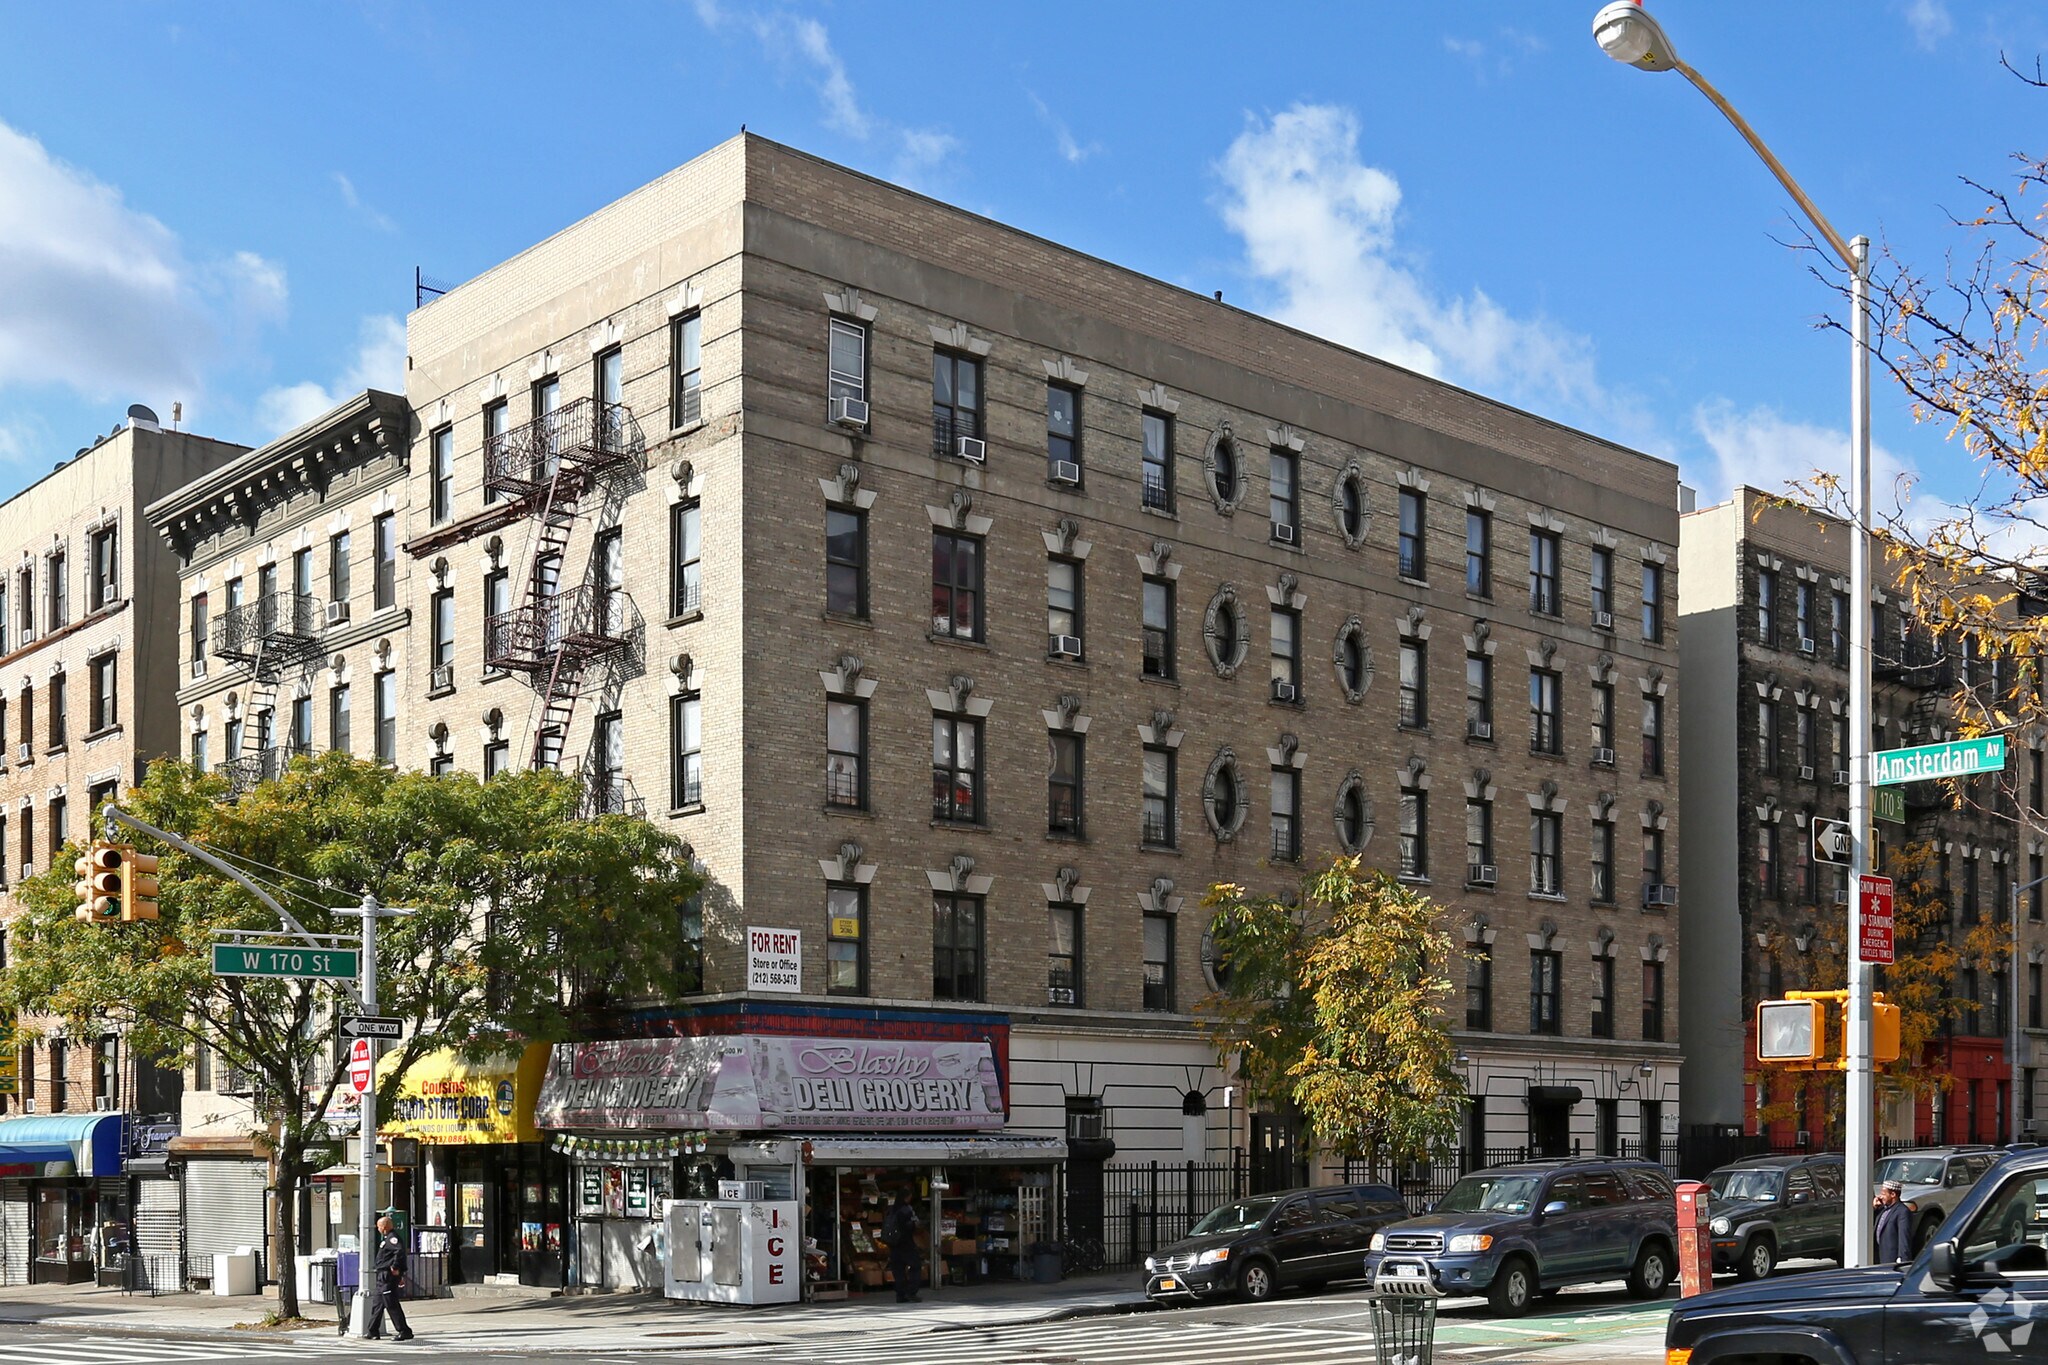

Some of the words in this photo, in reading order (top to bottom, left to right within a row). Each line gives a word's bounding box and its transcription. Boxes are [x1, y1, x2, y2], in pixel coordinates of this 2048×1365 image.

[1879, 746, 1979, 780] Amsterdam
[1986, 742, 2000, 758] Av
[1880, 791, 1895, 817] 170
[1897, 796, 1904, 811] St
[1860, 880, 1874, 893] SNOW
[1876, 883, 1892, 896] ROUTE
[1860, 913, 1867, 926] NO
[1868, 914, 1893, 929] STANDING
[1867, 929, 1884, 938] DURING
[751, 932, 771, 953] FOR
[773, 934, 797, 954] RENT
[1862, 937, 1889, 949] EMERGENCY
[242, 951, 260, 970] W
[270, 953, 303, 972] 170
[312, 954, 331, 972] St
[1879, 950, 1892, 959] TOWED
[752, 957, 770, 969] Store
[771, 961, 778, 970] or
[779, 959, 798, 971] Office
[752, 972, 769, 986] (212)
[770, 973, 798, 985] 568-3478
[358, 1023, 376, 1032] ONE
[378, 1024, 397, 1033] WAY
[799, 1046, 931, 1080] Blashy
[421, 1080, 466, 1095] Cousins
[561, 1076, 603, 1110] DELI
[604, 1074, 698, 1110] GROCERY
[792, 1077, 854, 1113] DELI
[856, 1077, 973, 1113] GROCERY
[428, 1096, 459, 1120] STORE
[461, 1095, 489, 1120] CORP.
[708, 1113, 724, 1126] FREE
[726, 1113, 757, 1126] DELIVERY
[723, 1189, 739, 1199] ICE
[767, 1208, 784, 1285] ICE
